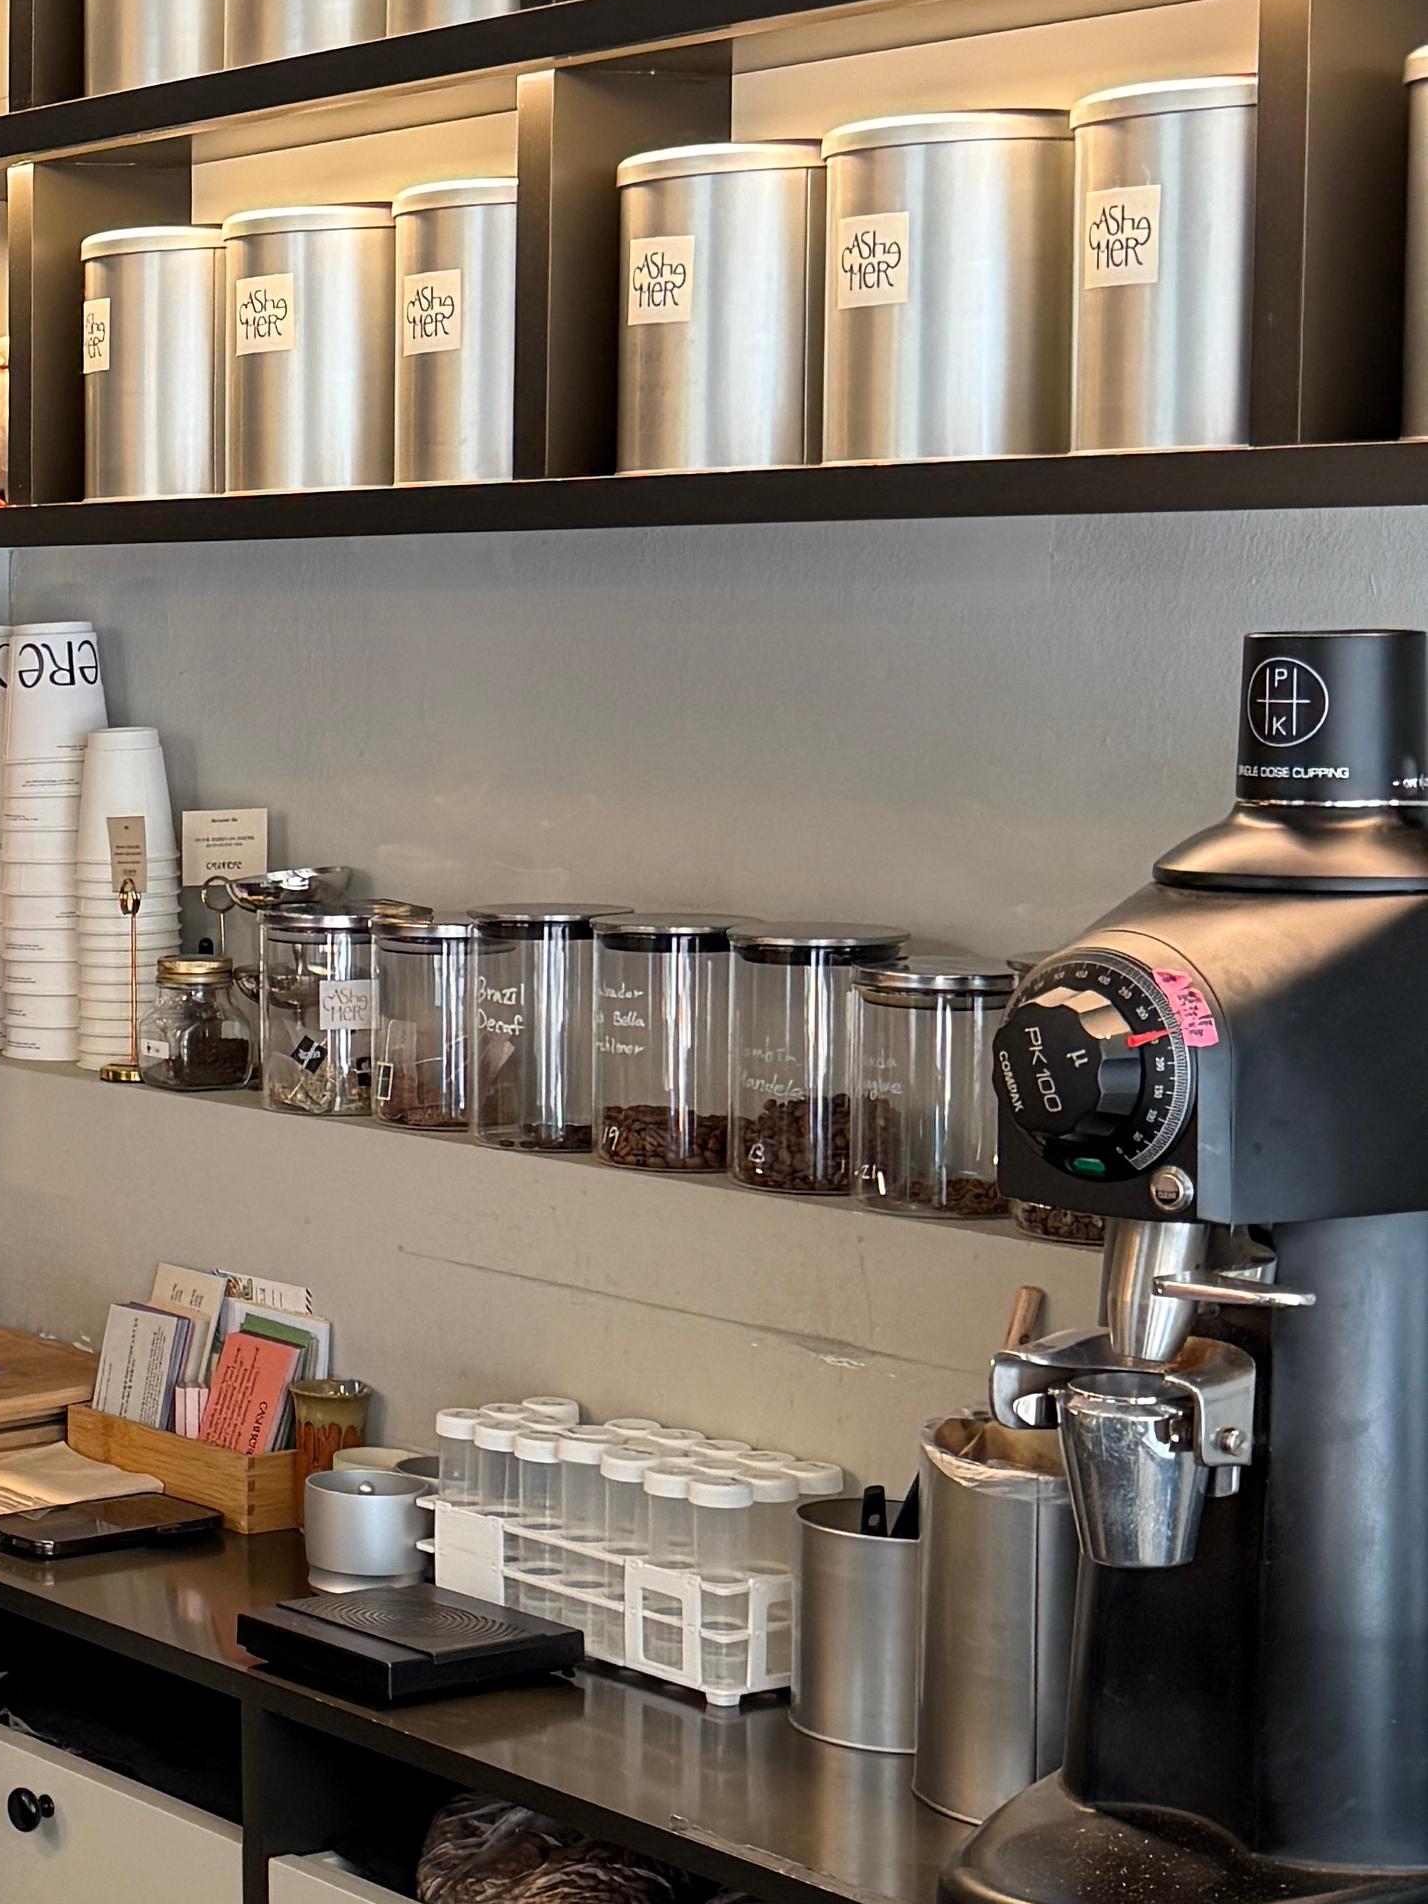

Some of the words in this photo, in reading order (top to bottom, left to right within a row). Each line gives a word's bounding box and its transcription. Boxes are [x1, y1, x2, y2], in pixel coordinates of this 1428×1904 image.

[1274, 668, 1288, 688] P
[1272, 715, 1287, 736] K
[998, 1050, 1025, 1113] COMPAK
